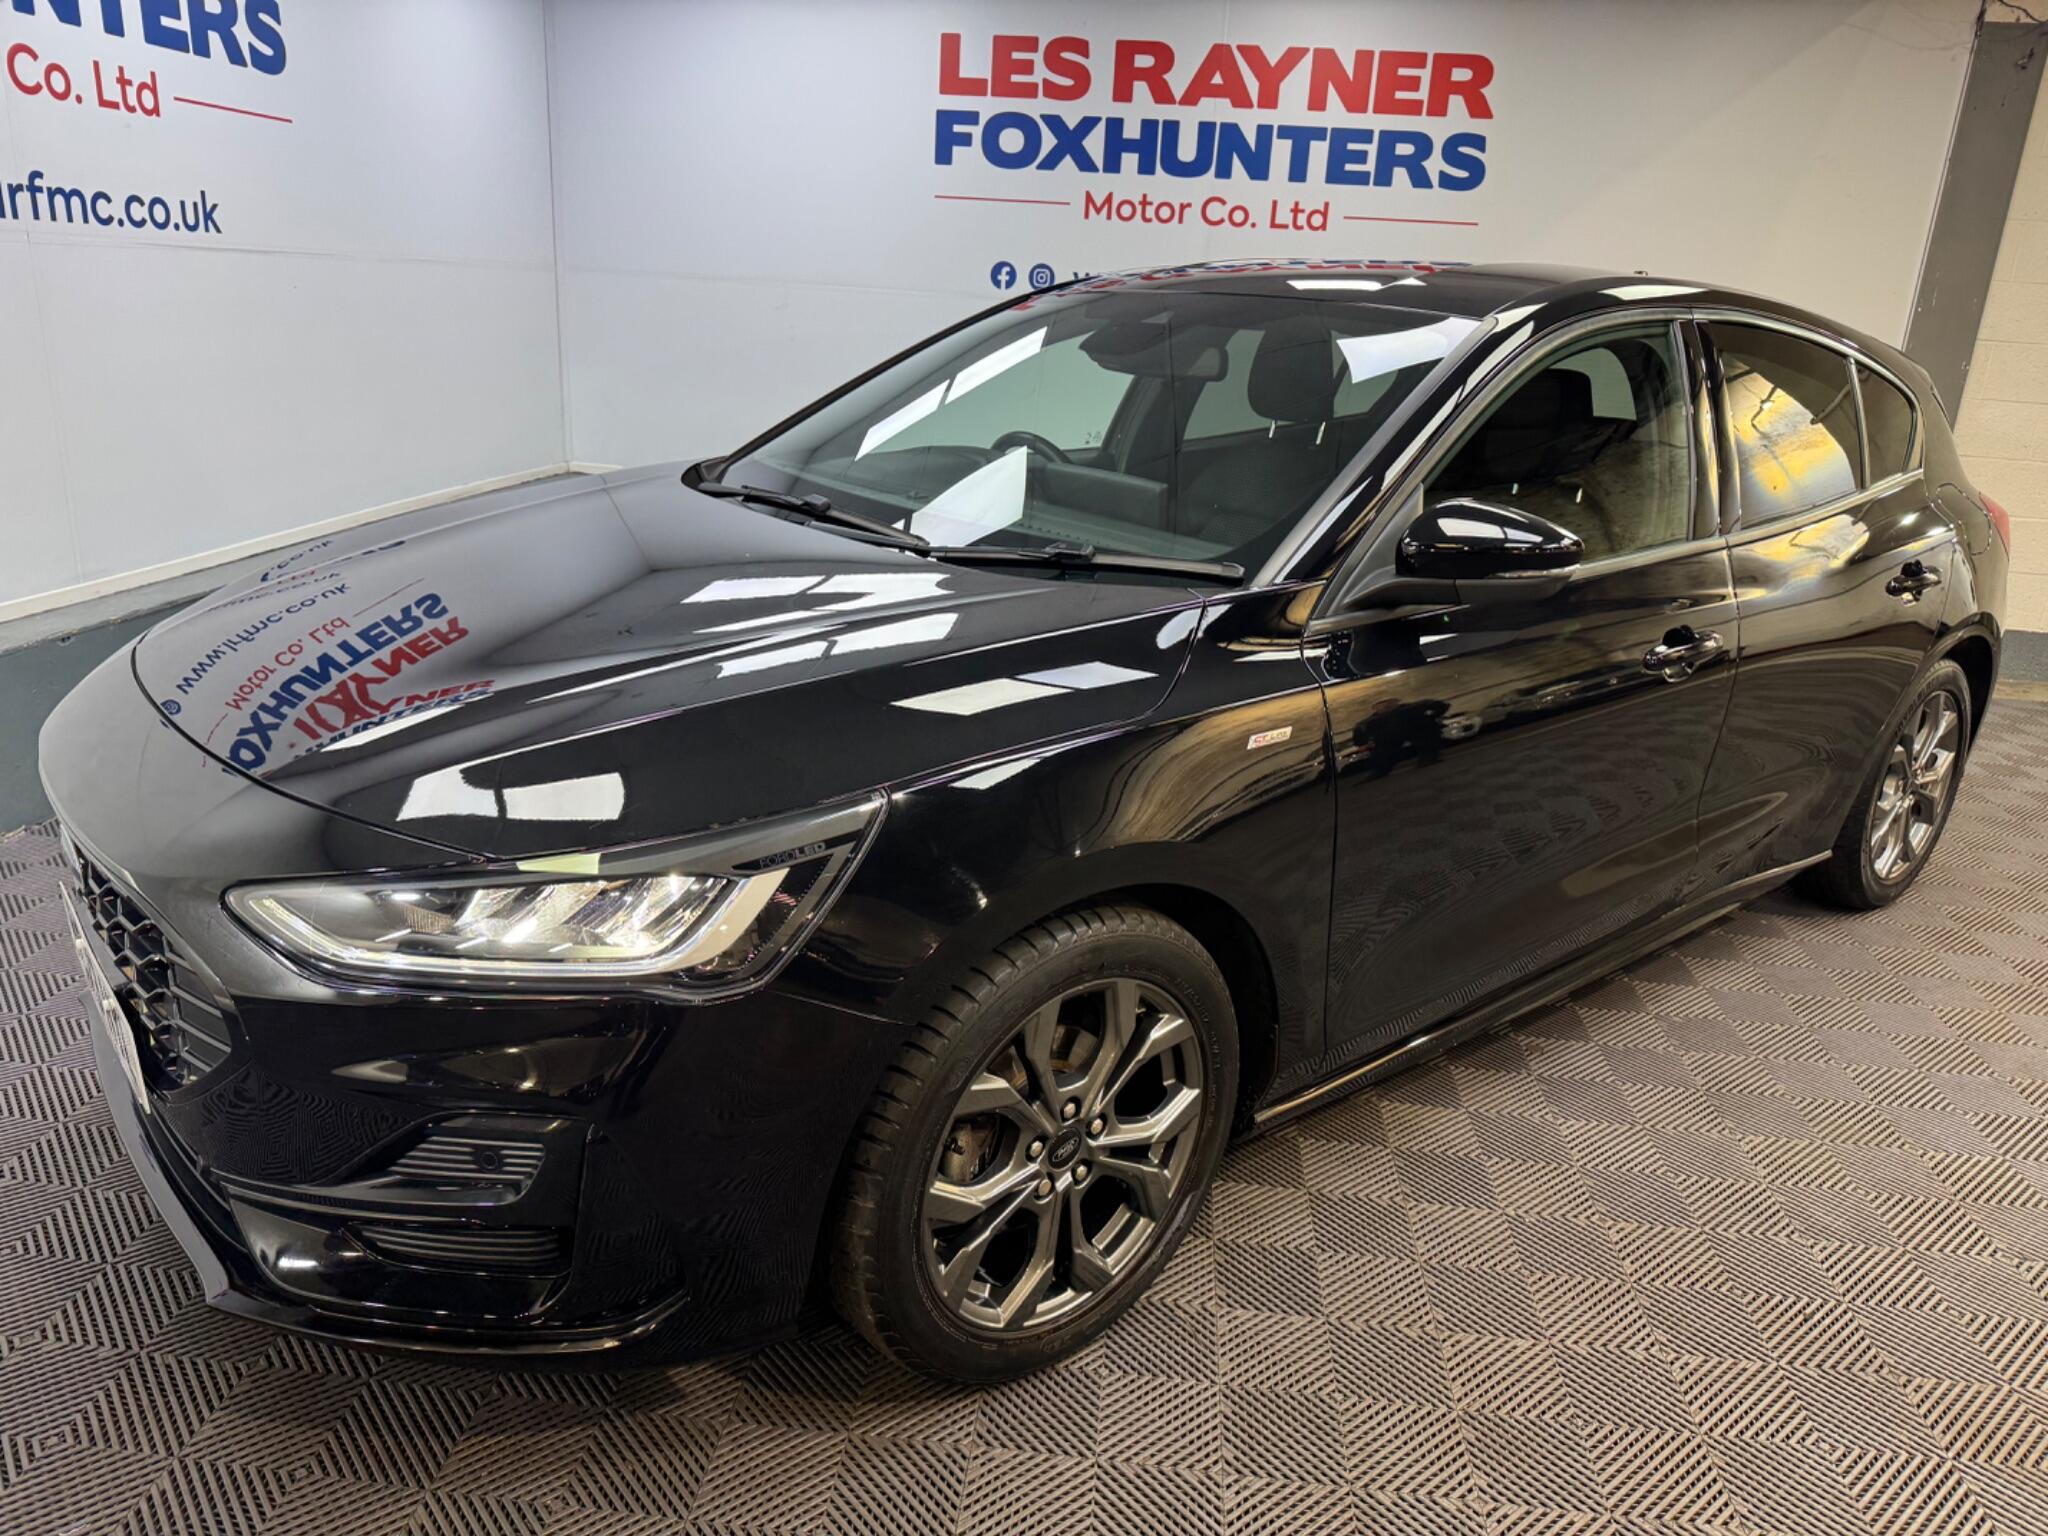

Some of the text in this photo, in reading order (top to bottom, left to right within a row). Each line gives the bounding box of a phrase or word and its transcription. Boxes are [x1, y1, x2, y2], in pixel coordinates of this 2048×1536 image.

[11, 0, 287, 76] ERS
[938, 32, 1494, 119] LES RAYNER
[6, 42, 161, 117] Co. Ltd
[934, 109, 1487, 192] FOXHUNTERS
[1083, 190, 1330, 232] Motor Co. Ltd
